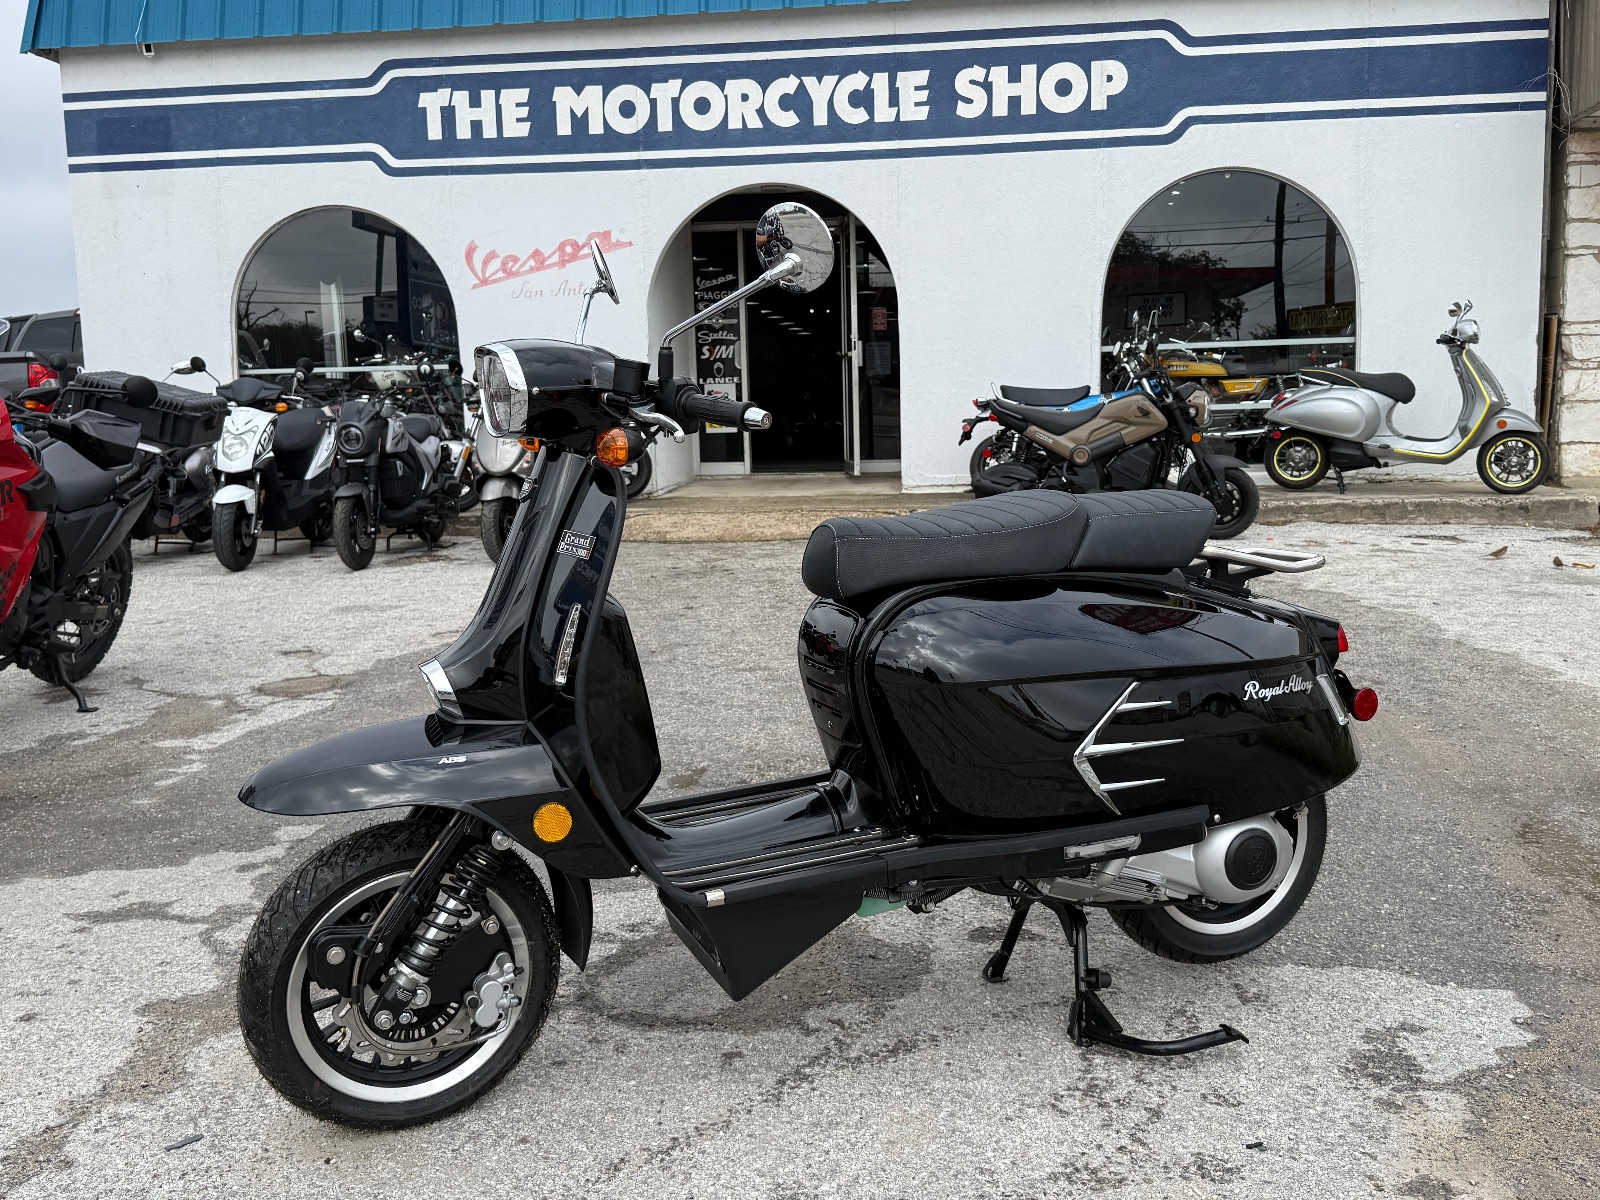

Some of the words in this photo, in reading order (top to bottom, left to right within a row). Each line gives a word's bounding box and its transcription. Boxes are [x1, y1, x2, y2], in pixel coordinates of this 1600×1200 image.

[418, 87, 531, 140] THE
[552, 69, 930, 136] MOTORCYCLE
[954, 59, 1129, 119] SHOP
[464, 230, 634, 290] Vespa
[512, 281, 544, 299] San
[696, 274, 738, 290] Vespa
[697, 330, 739, 344] Stella
[700, 345, 735, 361] SYM
[699, 376, 741, 385] LANCE
[559, 541, 577, 553] Prix
[564, 532, 591, 546] Grand
[1242, 679, 1285, 702] Royal
[1285, 673, 1313, 694] Alloy
[437, 755, 468, 765] ABS
